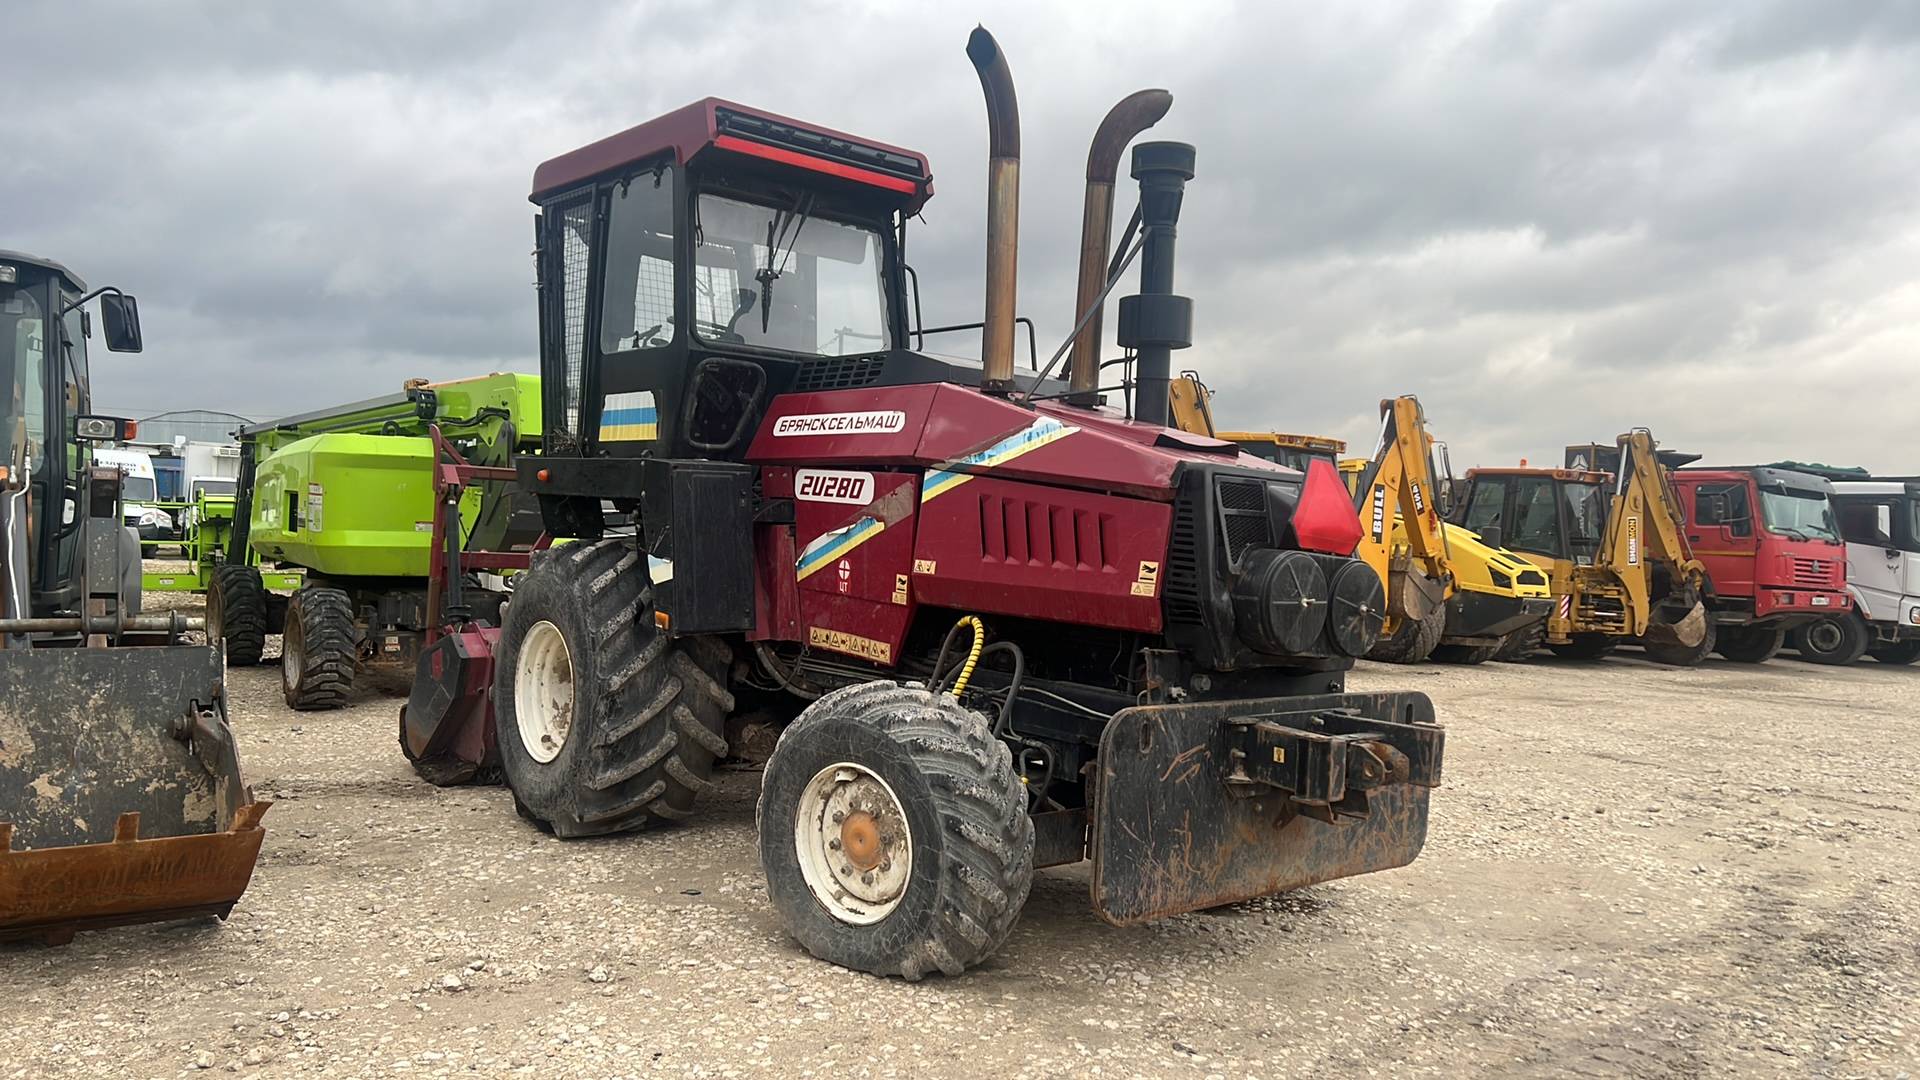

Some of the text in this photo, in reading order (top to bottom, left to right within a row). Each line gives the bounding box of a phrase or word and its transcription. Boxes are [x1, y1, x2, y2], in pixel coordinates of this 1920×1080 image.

[779, 415, 900, 432] БРЯНСКСЕЛЬМАШ
[800, 475, 865, 499] 2U280
[1373, 489, 1384, 533] BULL
